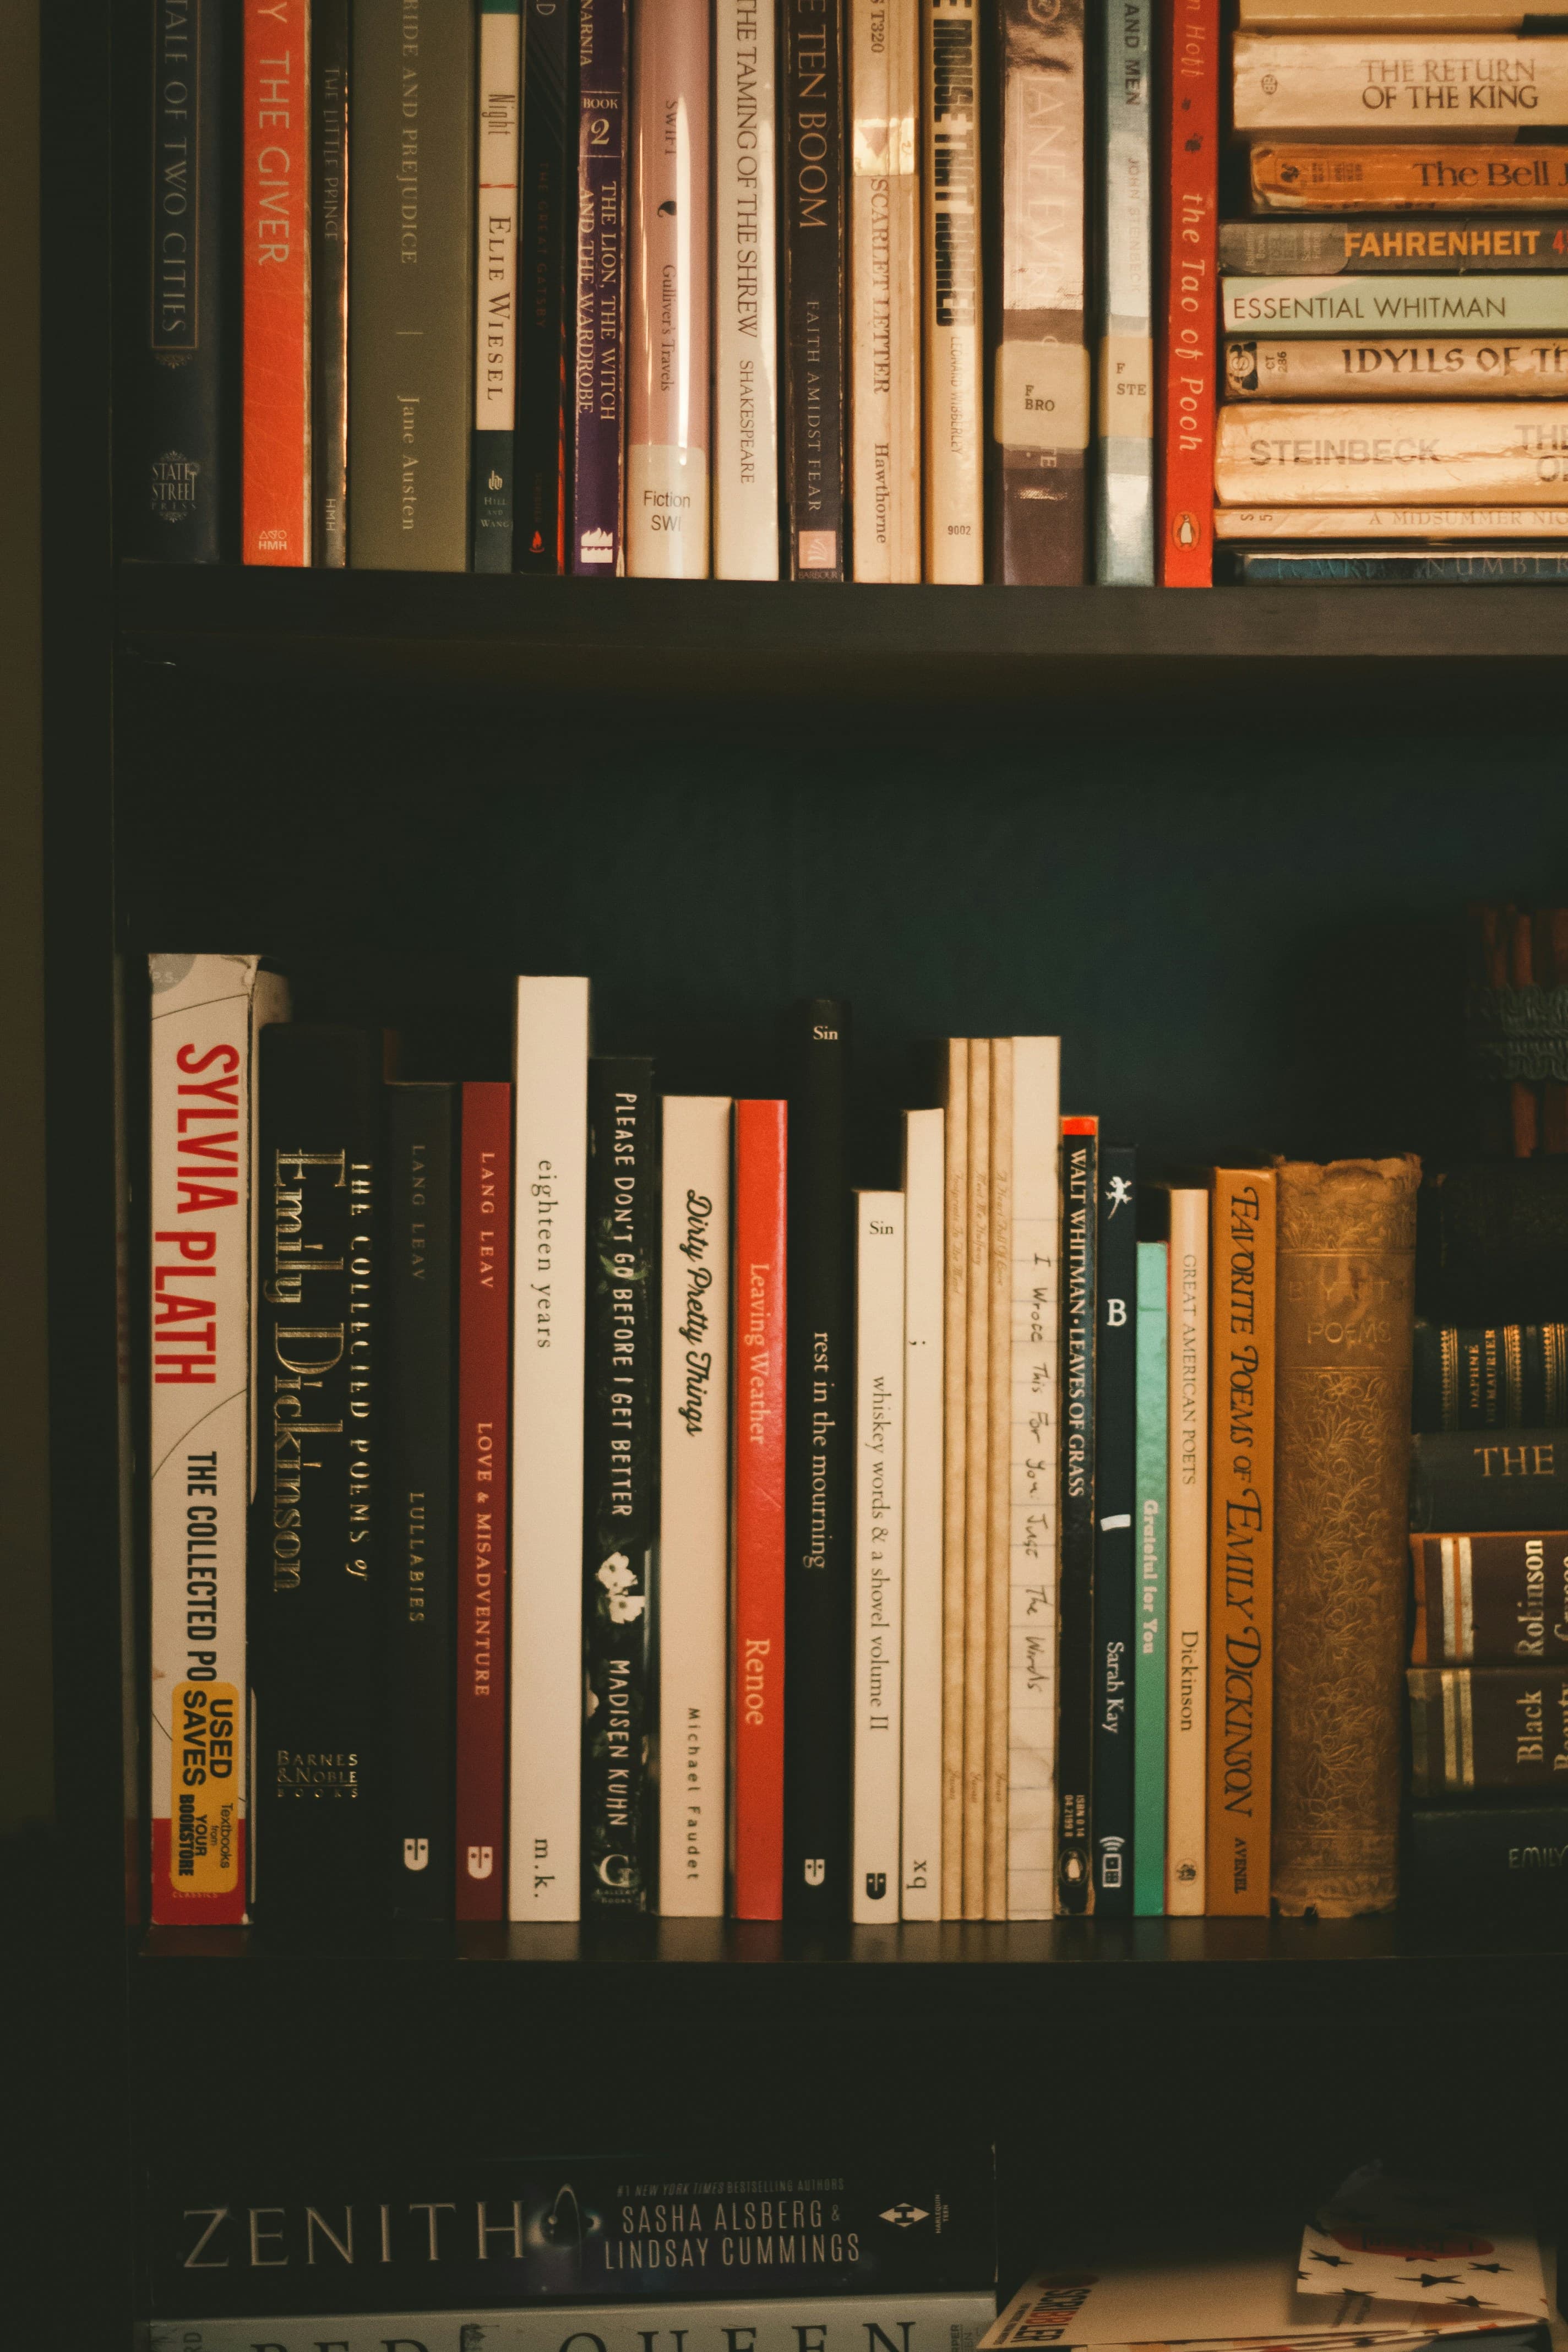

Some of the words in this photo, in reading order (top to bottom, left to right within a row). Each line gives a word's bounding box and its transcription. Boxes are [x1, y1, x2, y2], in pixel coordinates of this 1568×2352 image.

[1124, 4, 1140, 48] AND
[1180, 24, 1206, 78] Hoff
[259, 50, 290, 129] THE
[798, 24, 826, 99] TEN
[1125, 60, 1141, 106] MEN
[1360, 58, 1414, 83] THE
[1423, 58, 1536, 83] RETURN
[164, 80, 188, 120] OF
[402, 67, 419, 119] AND
[482, 94, 515, 136] Night
[583, 98, 619, 109] BOOK
[737, 47, 758, 150] TAMING
[1362, 85, 1397, 110] OF
[1405, 85, 1460, 109] THE
[1468, 85, 1538, 109] KING
[324, 110, 340, 167] LITTLE
[590, 118, 609, 145] 2
[163, 136, 188, 216] TWO
[396, 129, 418, 264] PREJUDICE
[737, 156, 758, 189] OF
[798, 112, 827, 228] BOOM
[1412, 160, 1479, 188] The
[1485, 160, 1550, 187] Bell
[258, 146, 290, 266] GIVER
[579, 187, 595, 234] AND
[601, 181, 617, 225] THE
[737, 194, 758, 244] THE
[1182, 193, 1206, 244] the
[488, 217, 511, 281] ELIE
[579, 241, 595, 285] THE
[599, 233, 617, 288] LION,
[870, 178, 891, 296] SCARLET
[1344, 230, 1540, 257] FAHRENHEIT
[162, 232, 188, 331] CITIES
[737, 249, 758, 338] SHREW
[1180, 259, 1206, 313] Tao
[1233, 297, 1365, 319] ESSENTIAL
[1374, 296, 1506, 318] WHITMAN
[487, 292, 511, 401] WIESEL
[600, 295, 617, 340] THE
[807, 300, 821, 363] FAITH
[872, 297, 891, 395] LETTER
[1176, 328, 1204, 361] of
[578, 292, 595, 414] WARDROBE
[661, 339, 676, 392] Travels
[950, 336, 963, 388] LEONARD
[1116, 362, 1125, 374] F
[1342, 347, 1466, 374] IDYLLS
[1476, 347, 1521, 375] OF
[600, 347, 616, 421] WITCH
[807, 372, 821, 452] AMIDST
[1025, 385, 1034, 396] F
[1025, 399, 1055, 412] BRO
[1116, 383, 1146, 396] STE
[396, 395, 420, 445] Jane
[739, 360, 755, 484] SHAKESPEARE
[1179, 377, 1204, 451] Pooh
[1249, 439, 1441, 467] STEINBECK
[326, 498, 336, 531] HMH
[402, 454, 420, 530] Austen
[484, 496, 508, 506] HILL
[644, 490, 690, 508] Fiction
[808, 459, 822, 512] FEAR
[874, 442, 891, 544] Hawthorne
[258, 540, 287, 551] HMH
[480, 519, 513, 528] WANG
[948, 525, 971, 536] 9002
[1369, 511, 1382, 525] A
[812, 1026, 839, 1041] Sin
[176, 1043, 240, 1214] SYLVIA
[613, 1091, 638, 1167] PLEASE
[349, 1161, 374, 1217] THE
[412, 1145, 426, 1206] LANG
[480, 1151, 495, 1215] LANG
[1070, 1148, 1087, 1204] WALT
[263, 1146, 346, 1304] Emily
[531, 1159, 559, 1273] eighteen
[612, 1176, 635, 1243] DON'T
[679, 1188, 713, 1263] Dirty
[869, 1220, 895, 1235] Sin
[411, 1224, 426, 1281] LEAV
[478, 1231, 495, 1288] LEAV
[613, 1253, 636, 1279] GO
[1069, 1209, 1086, 1315] WHITMAN
[1229, 1186, 1259, 1335] FAVORITE
[155, 1231, 217, 1384] PLATH
[679, 1266, 713, 1347] Pretty
[744, 1262, 770, 1347] Leaving
[1182, 1253, 1197, 1317] GREAT
[348, 1235, 374, 1419] COLLECTED
[530, 1282, 552, 1349] years
[611, 1287, 635, 1366] BEFORE
[814, 1331, 829, 1371] rest
[1031, 1362, 1049, 1393] This
[1069, 1329, 1086, 1399] LEAVES
[1182, 1323, 1196, 1423] AMERICAN
[610, 1392, 633, 1430] GET
[678, 1351, 711, 1437] Things
[749, 1352, 772, 1445] Weather
[813, 1381, 836, 1403] in
[864, 1375, 892, 1454] whiskey
[1068, 1402, 1085, 1430] OF
[1229, 1345, 1259, 1448] POEMS
[274, 1321, 345, 1591] Dickinson
[475, 1422, 493, 1483] LOVE
[813, 1411, 836, 1447] the
[1182, 1430, 1196, 1485] POETS
[187, 1451, 217, 1497] THE
[609, 1438, 633, 1517] BETTER
[871, 1460, 891, 1519] words
[1069, 1434, 1085, 1498] GRASS
[1233, 1455, 1253, 1483] OF
[1473, 1443, 1555, 1478] THE
[348, 1438, 372, 1543] POEMS
[475, 1491, 489, 1505] &
[802, 1455, 834, 1569] mourning
[409, 1492, 426, 1623] LULLABIES
[871, 1526, 889, 1543] &
[871, 1550, 884, 1561] a
[1143, 1499, 1159, 1580] Grateful
[1226, 1488, 1262, 1620] EMILY
[187, 1505, 217, 1641] COLLECTED
[870, 1568, 891, 1627] shovel
[1143, 1586, 1159, 1613] for
[1514, 1539, 1545, 1657] Robinson
[473, 1513, 493, 1697] MISADVENTURE
[1143, 1616, 1159, 1654] You
[744, 1637, 771, 1726] Renoe
[870, 1634, 891, 1709] volume
[1106, 1641, 1124, 1692] Sarah
[1180, 1630, 1199, 1733] Dickinson
[607, 1658, 631, 1759] MADISEN
[1102, 1698, 1124, 1734] Kay
[1223, 1626, 1262, 1818] DICKINSON
[1515, 1689, 1544, 1765] Black
[183, 1690, 207, 1787] SAVES
[210, 1698, 233, 1779] USED
[687, 1707, 701, 1793] Michael
[607, 1768, 630, 1828] KUHN
[178, 1794, 195, 1876] BOOKSTORE
[195, 1814, 208, 1856] YOUR
[220, 1803, 233, 1869] Textbooks
[686, 1805, 701, 1879] Faudet
[1234, 1837, 1248, 1894] AVENEL
[635, 2183, 658, 2196] NEW
[663, 2182, 690, 2196] YORK
[693, 2181, 725, 2195] TIMES
[797, 2177, 845, 2193] AUTHORS
[183, 2200, 525, 2268] ZENITH
[622, 2203, 703, 2234] SASHA
[716, 2200, 823, 2233] ALSBERG
[831, 2204, 840, 2222] &
[605, 2237, 709, 2269] LINDSAY
[722, 2233, 861, 2266] CUMMINGS
[1010, 2288, 1093, 2343] SCRIBBLER
